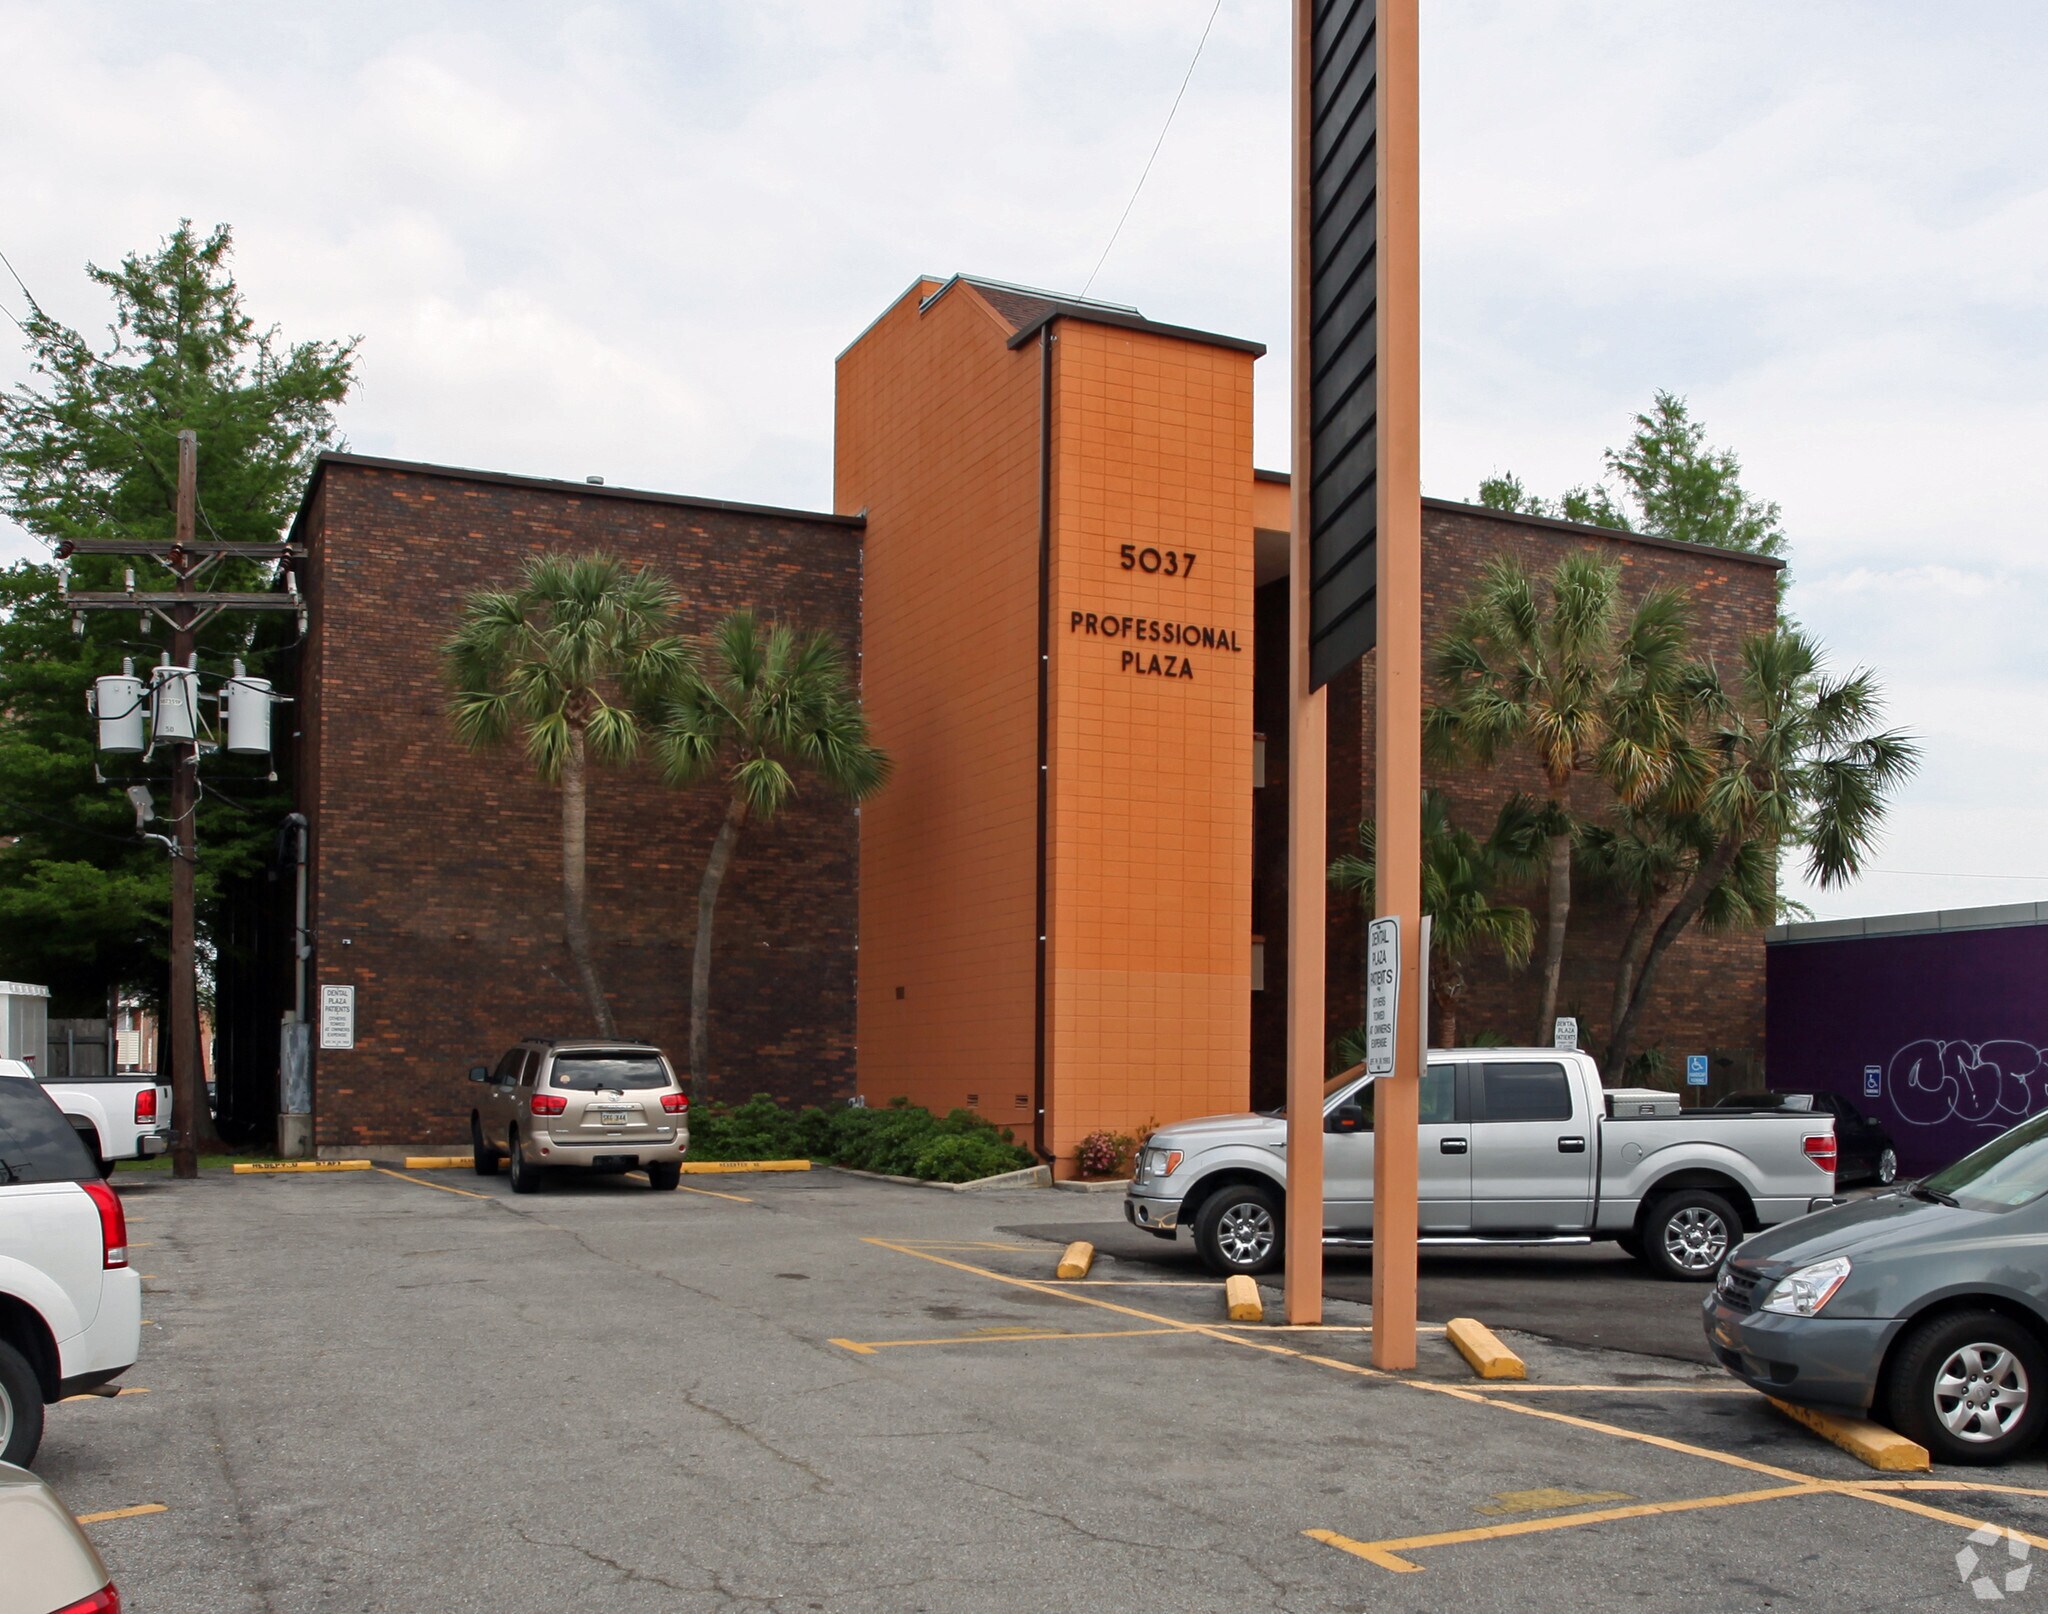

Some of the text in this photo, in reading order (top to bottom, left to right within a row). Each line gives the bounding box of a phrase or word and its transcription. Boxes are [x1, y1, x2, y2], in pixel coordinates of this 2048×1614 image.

[1120, 543, 1197, 578] 5037
[1070, 611, 1242, 652] PROFESSIONAL
[1121, 650, 1194, 680] PLAZA
[1371, 929, 1389, 946] DENTAL
[1372, 949, 1387, 966] PLAZA
[1370, 968, 1393, 986] PATIENTS
[325, 1005, 350, 1013] PATIENTS
